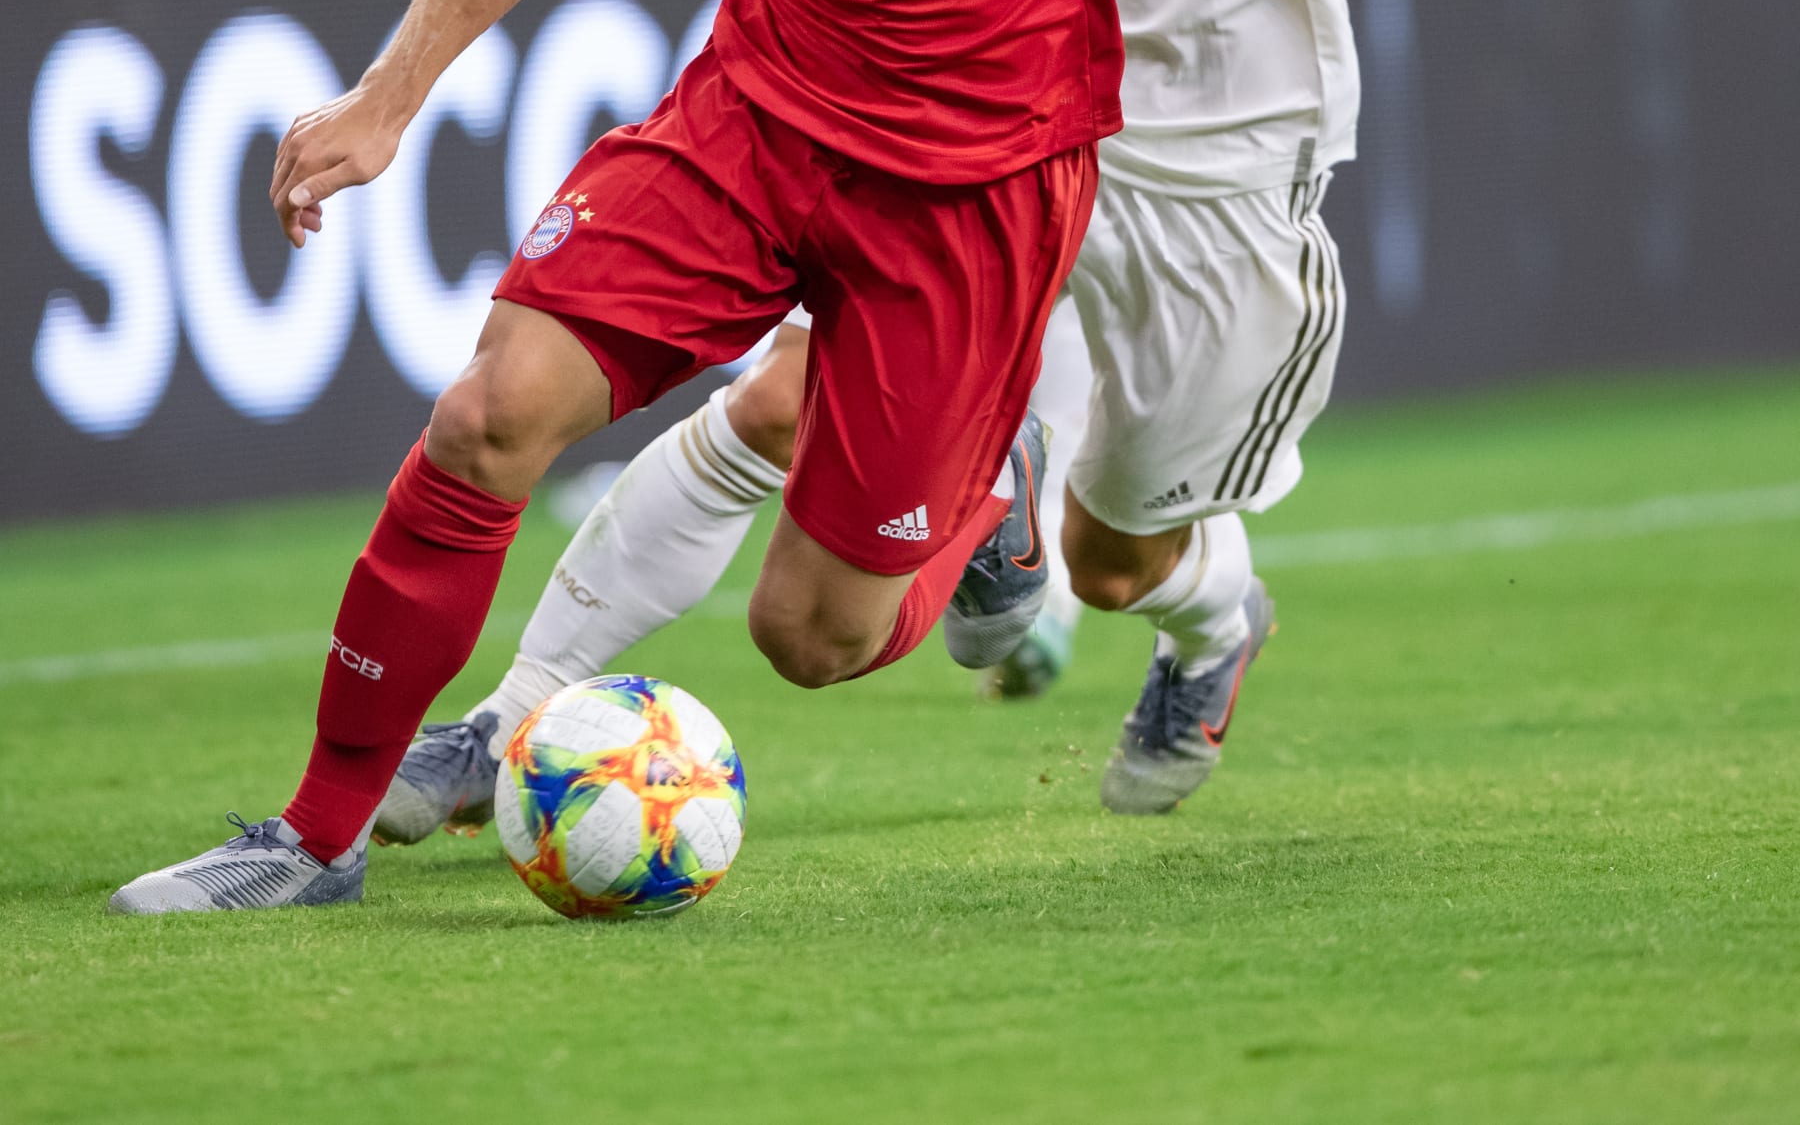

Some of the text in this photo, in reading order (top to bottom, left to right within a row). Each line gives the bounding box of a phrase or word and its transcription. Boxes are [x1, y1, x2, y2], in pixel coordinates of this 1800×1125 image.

[877, 523, 931, 540] adidas
[555, 566, 610, 609] MCF
[329, 634, 383, 681] FCB
